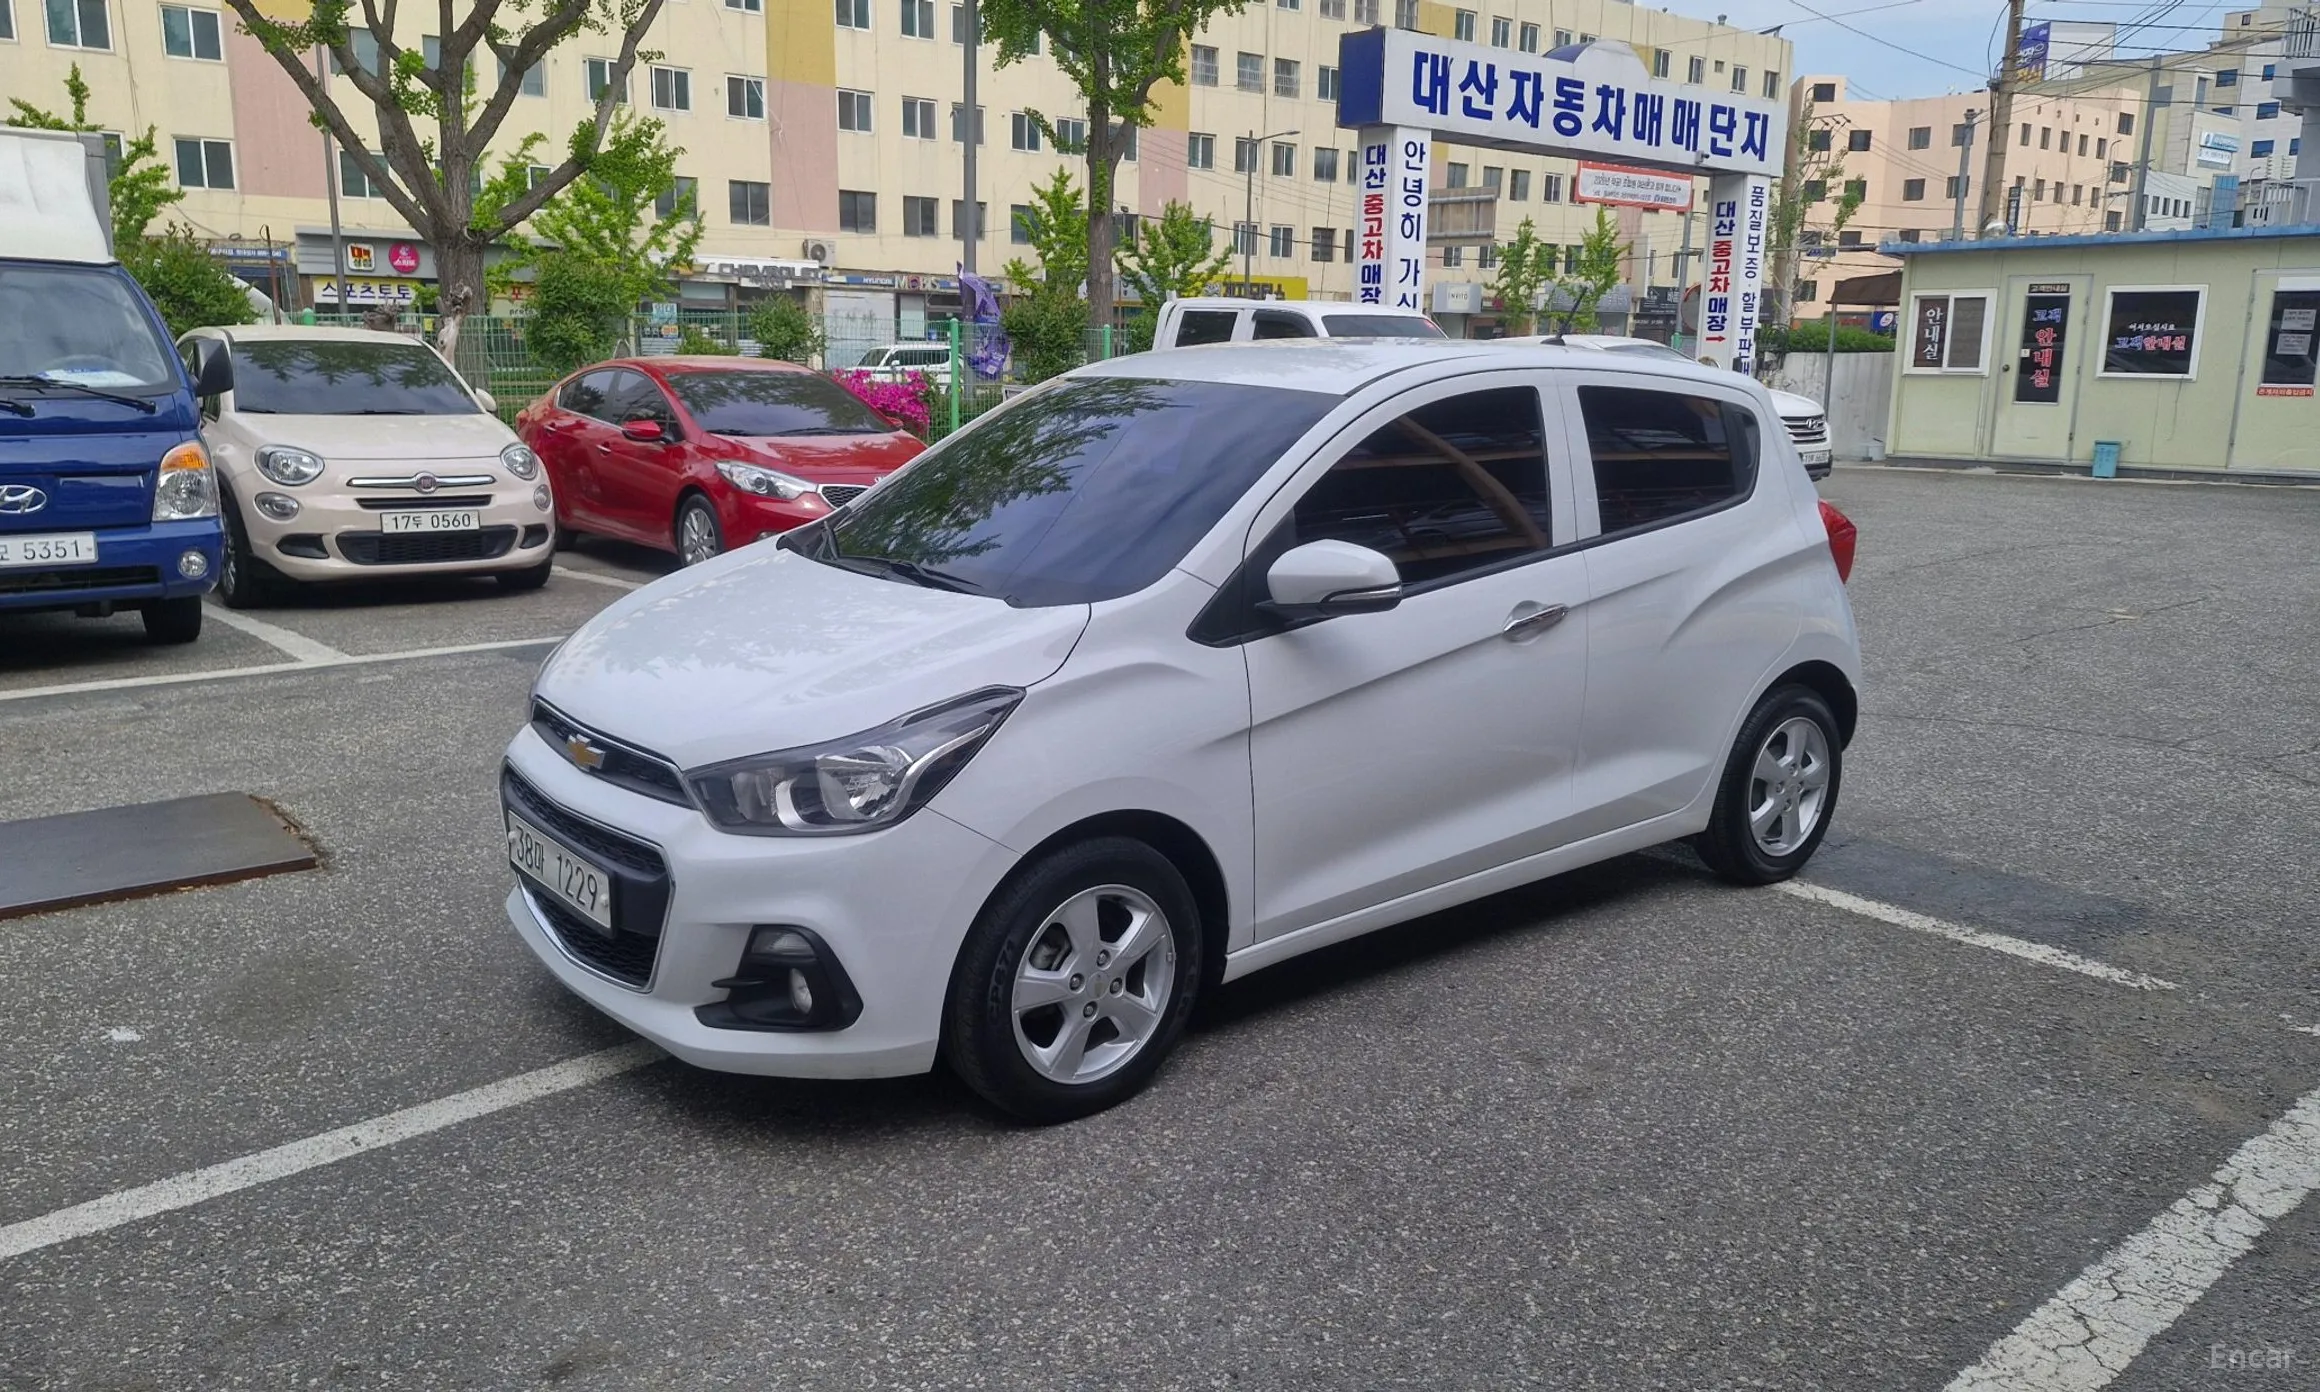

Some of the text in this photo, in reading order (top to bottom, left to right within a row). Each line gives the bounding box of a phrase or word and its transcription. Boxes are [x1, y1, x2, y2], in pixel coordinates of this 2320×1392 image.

[1412, 51, 1770, 162] 대산자동차매매단지
[1365, 143, 1387, 189] 대산
[1400, 141, 1426, 242] 안녕히
[1362, 193, 1384, 260] 중고차
[322, 281, 413, 301] 스포츠토토
[719, 262, 821, 279] CHEVROLET
[1707, 200, 1736, 332] 대산 중고차 매장
[1923, 307, 1944, 360] 안내실
[2032, 308, 2062, 323] 고객
[2030, 327, 2057, 388] 안내실
[392, 513, 471, 530] 17두 0560
[23, 540, 79, 560] 5351
[516, 824, 598, 911] 38마 1229
